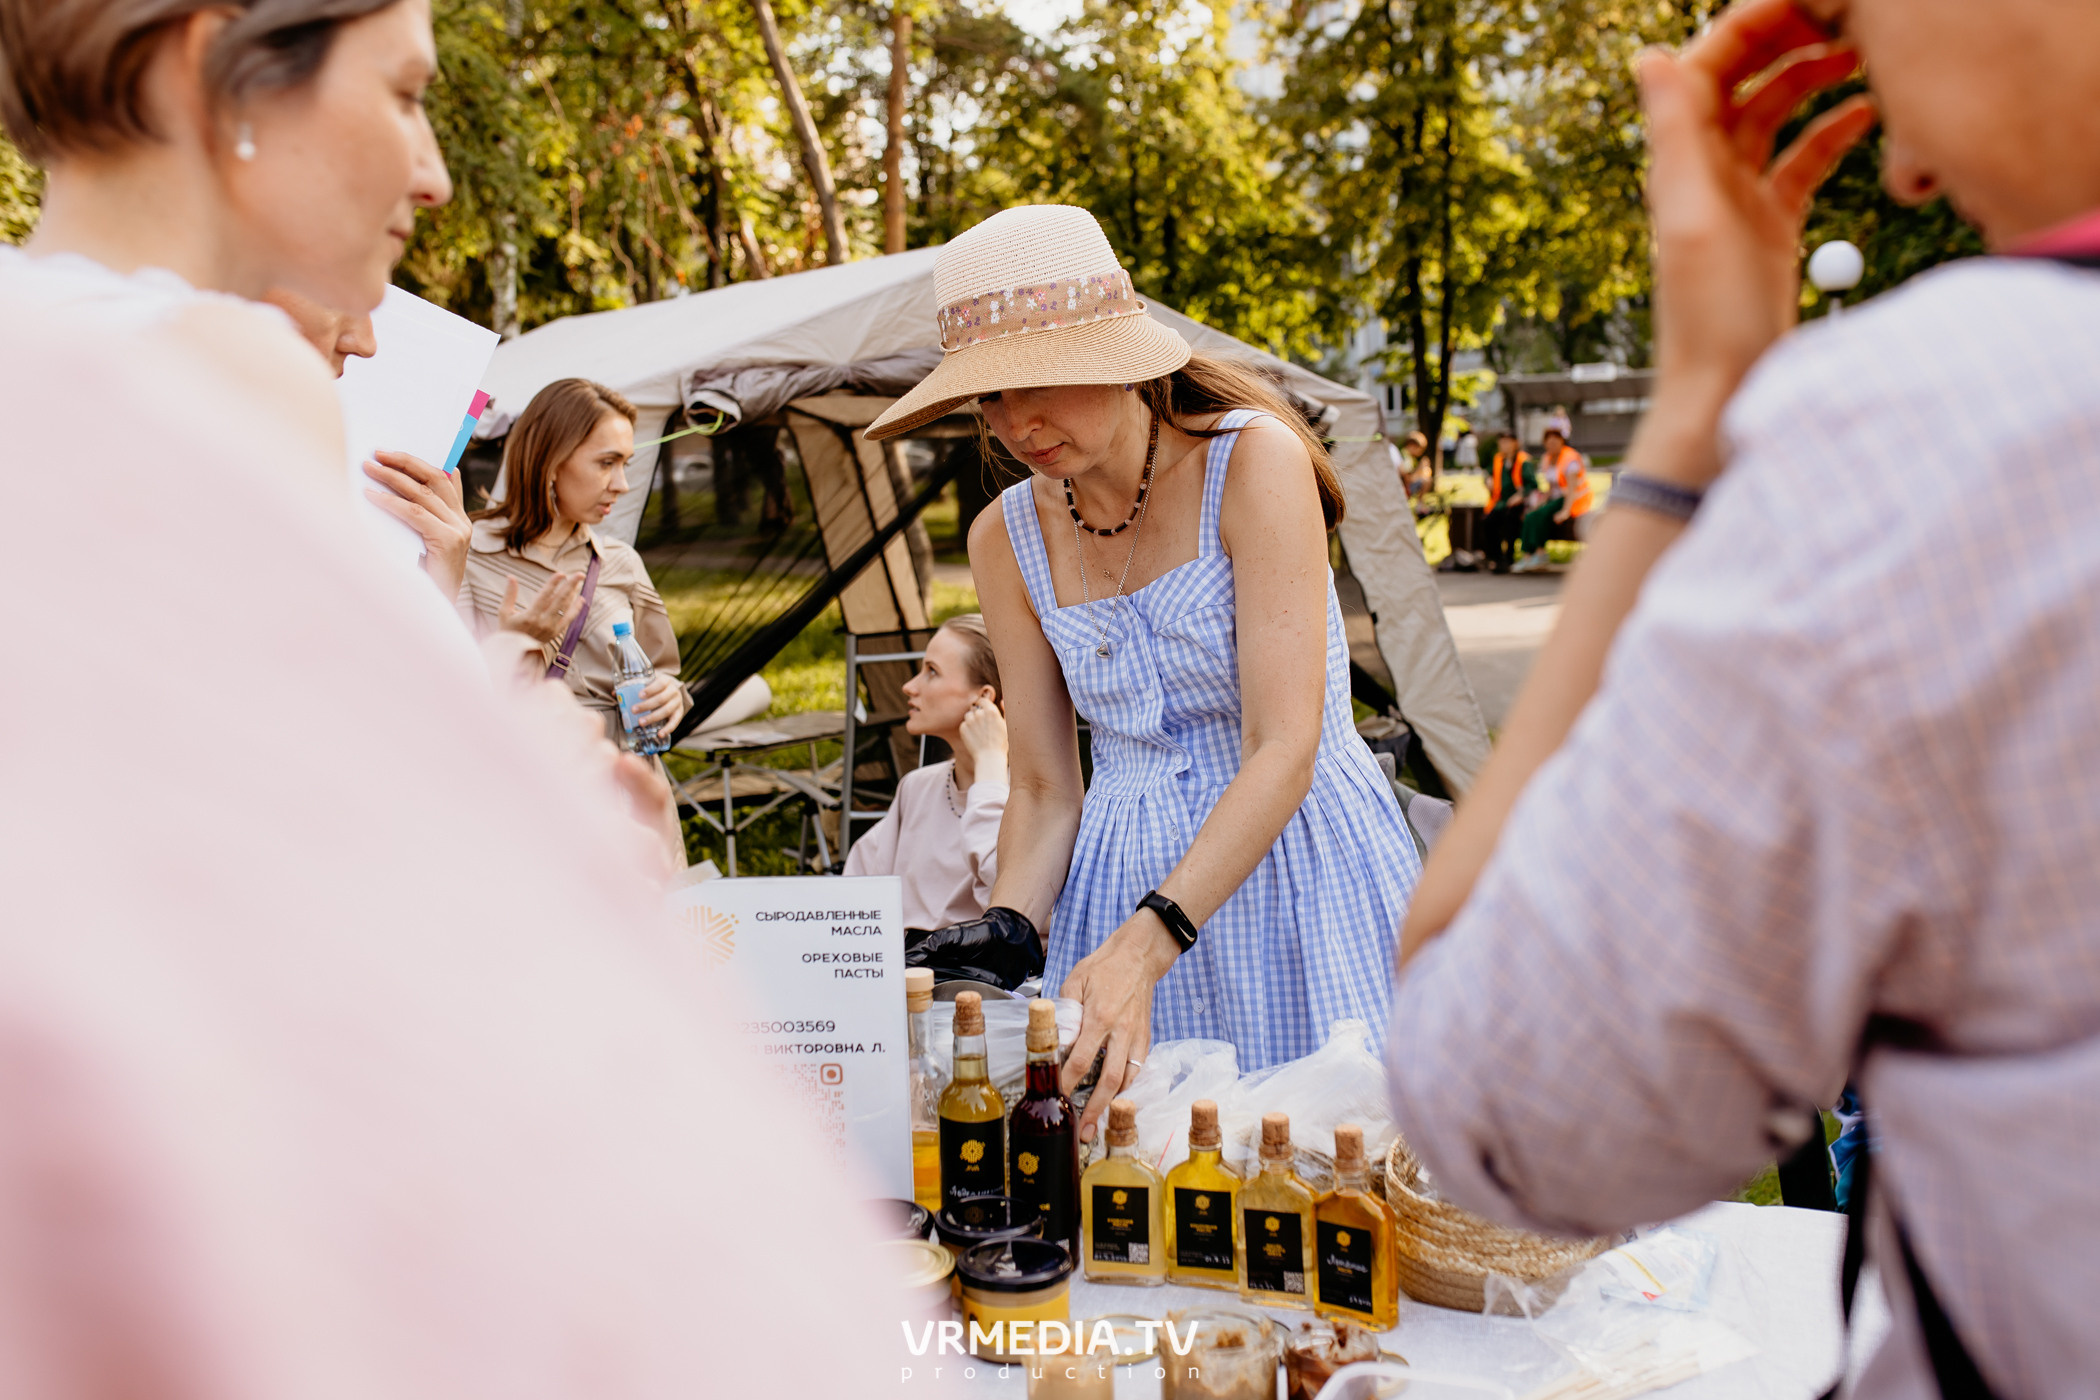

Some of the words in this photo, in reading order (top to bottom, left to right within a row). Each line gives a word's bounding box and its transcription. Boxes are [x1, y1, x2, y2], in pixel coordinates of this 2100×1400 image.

[756, 910, 882, 922] СЫРОДАВЛЕННЫЕ
[831, 925, 882, 937] МАСЛА
[802, 952, 883, 964] ОРЕХОВЫЕ
[834, 968, 884, 979] ПАСТЫ
[764, 1043, 865, 1055] ВИКТОРОВНА
[871, 1042, 886, 1053] Л.
